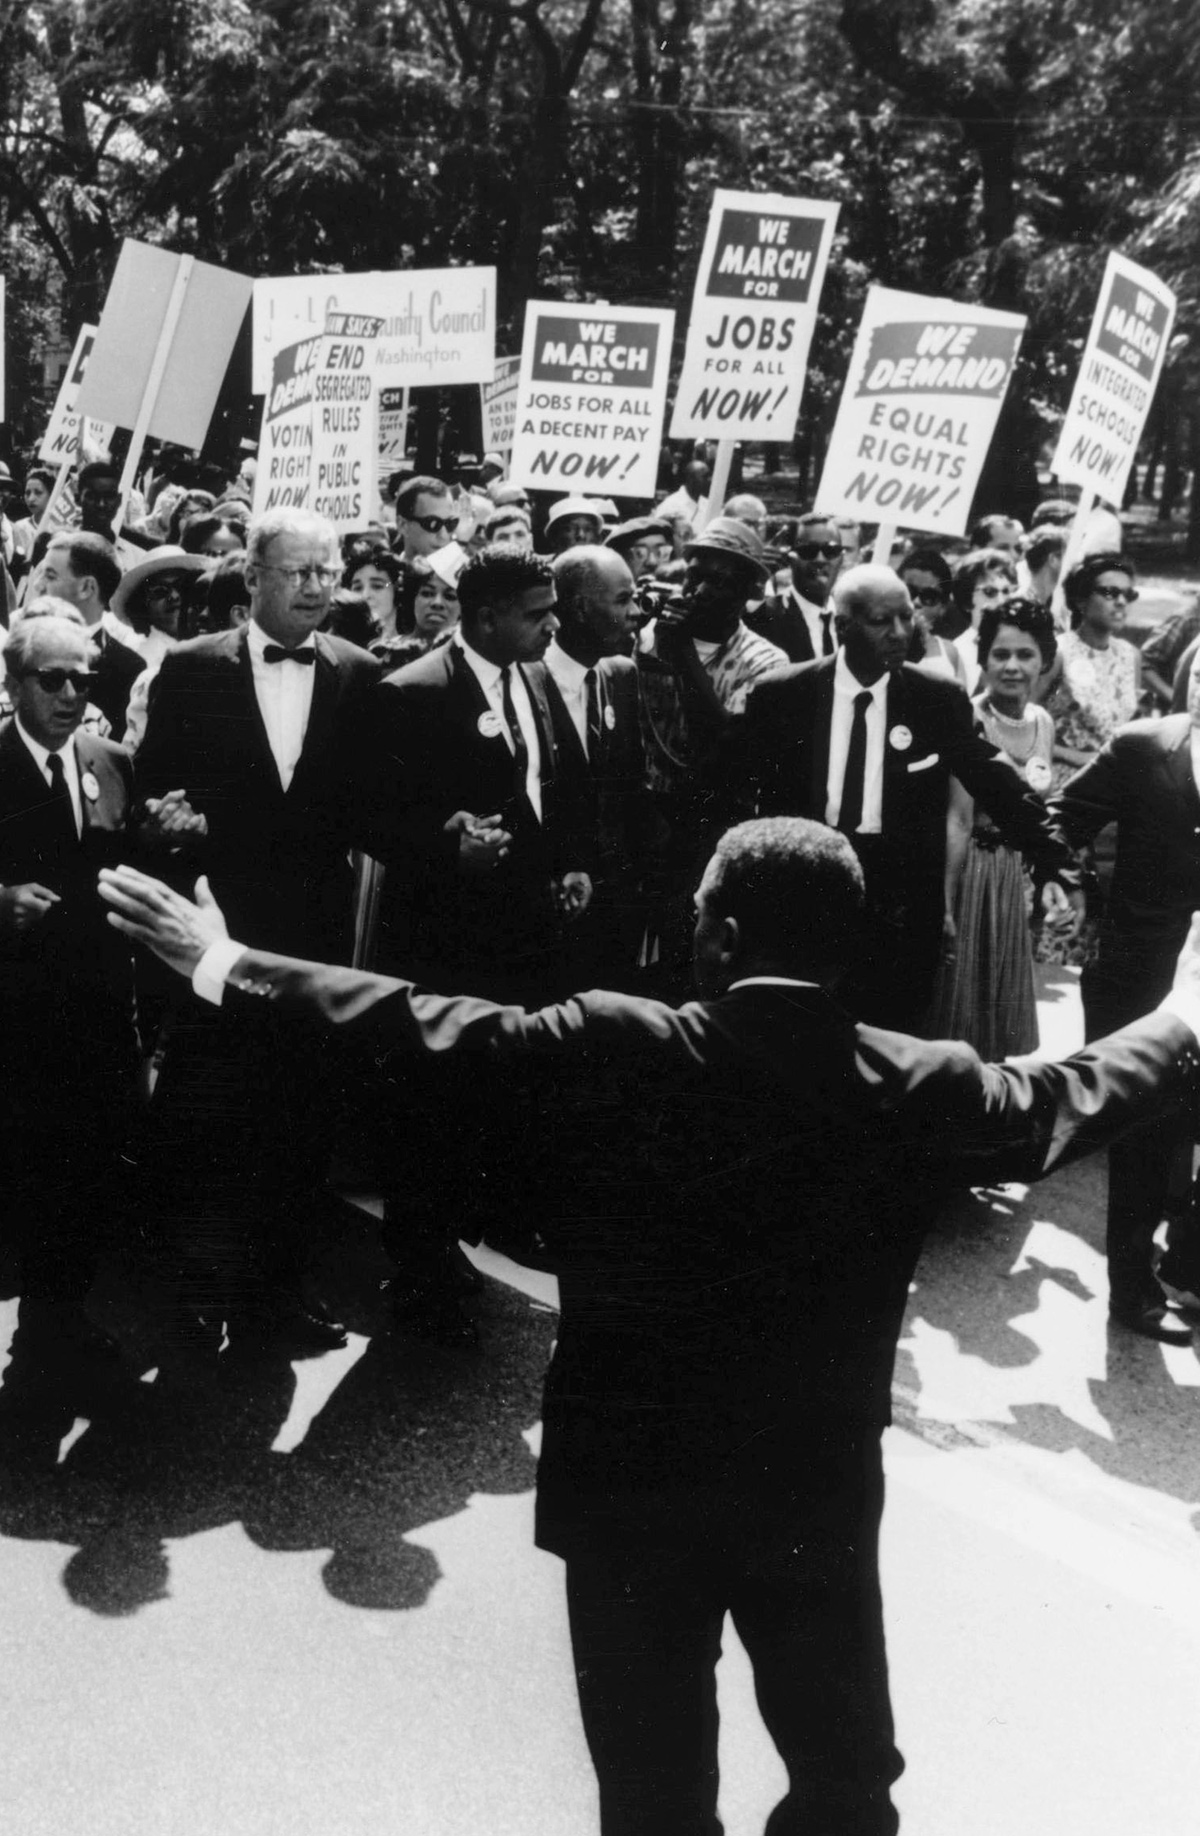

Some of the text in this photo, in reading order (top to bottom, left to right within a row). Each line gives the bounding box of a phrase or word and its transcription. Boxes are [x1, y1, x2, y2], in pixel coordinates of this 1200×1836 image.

[758, 218, 790, 244] WE
[718, 244, 812, 280] MARCH
[743, 280, 778, 297] FOR
[429, 288, 487, 334] Council
[1135, 290, 1156, 321] WE
[579, 322, 617, 343] WE
[706, 314, 796, 351] JOBS
[915, 324, 977, 356] WE
[1104, 305, 1161, 361] MARCH
[326, 344, 365, 370] END
[541, 342, 648, 370] MARCH
[704, 358, 785, 376] FOR ALL
[1118, 345, 1142, 368] FOR
[572, 369, 614, 384] FOR
[866, 357, 1006, 390] DEMAND
[1086, 358, 1148, 413] INTEGRATED
[315, 375, 372, 402] SEGREGATED
[489, 401, 517, 414] AN EN
[526, 393, 652, 416] JOBS FOR ALL
[690, 386, 789, 422] NOW!
[322, 407, 361, 433] RULES
[490, 416, 502, 427] TO
[521, 419, 650, 442] A DECENT PAY
[869, 402, 969, 447] EQUAL
[1077, 395, 1138, 446] SCHOOLS
[270, 425, 313, 449] VOTIN
[332, 443, 348, 458] IN
[270, 455, 311, 479] RIGHT
[530, 450, 640, 480] NOW!
[857, 434, 966, 480] RIGHTS
[1069, 434, 1127, 482] NOW!
[318, 460, 361, 490] PUBLIC
[314, 492, 362, 521] SCHOOLS
[844, 471, 961, 517] NOW!
